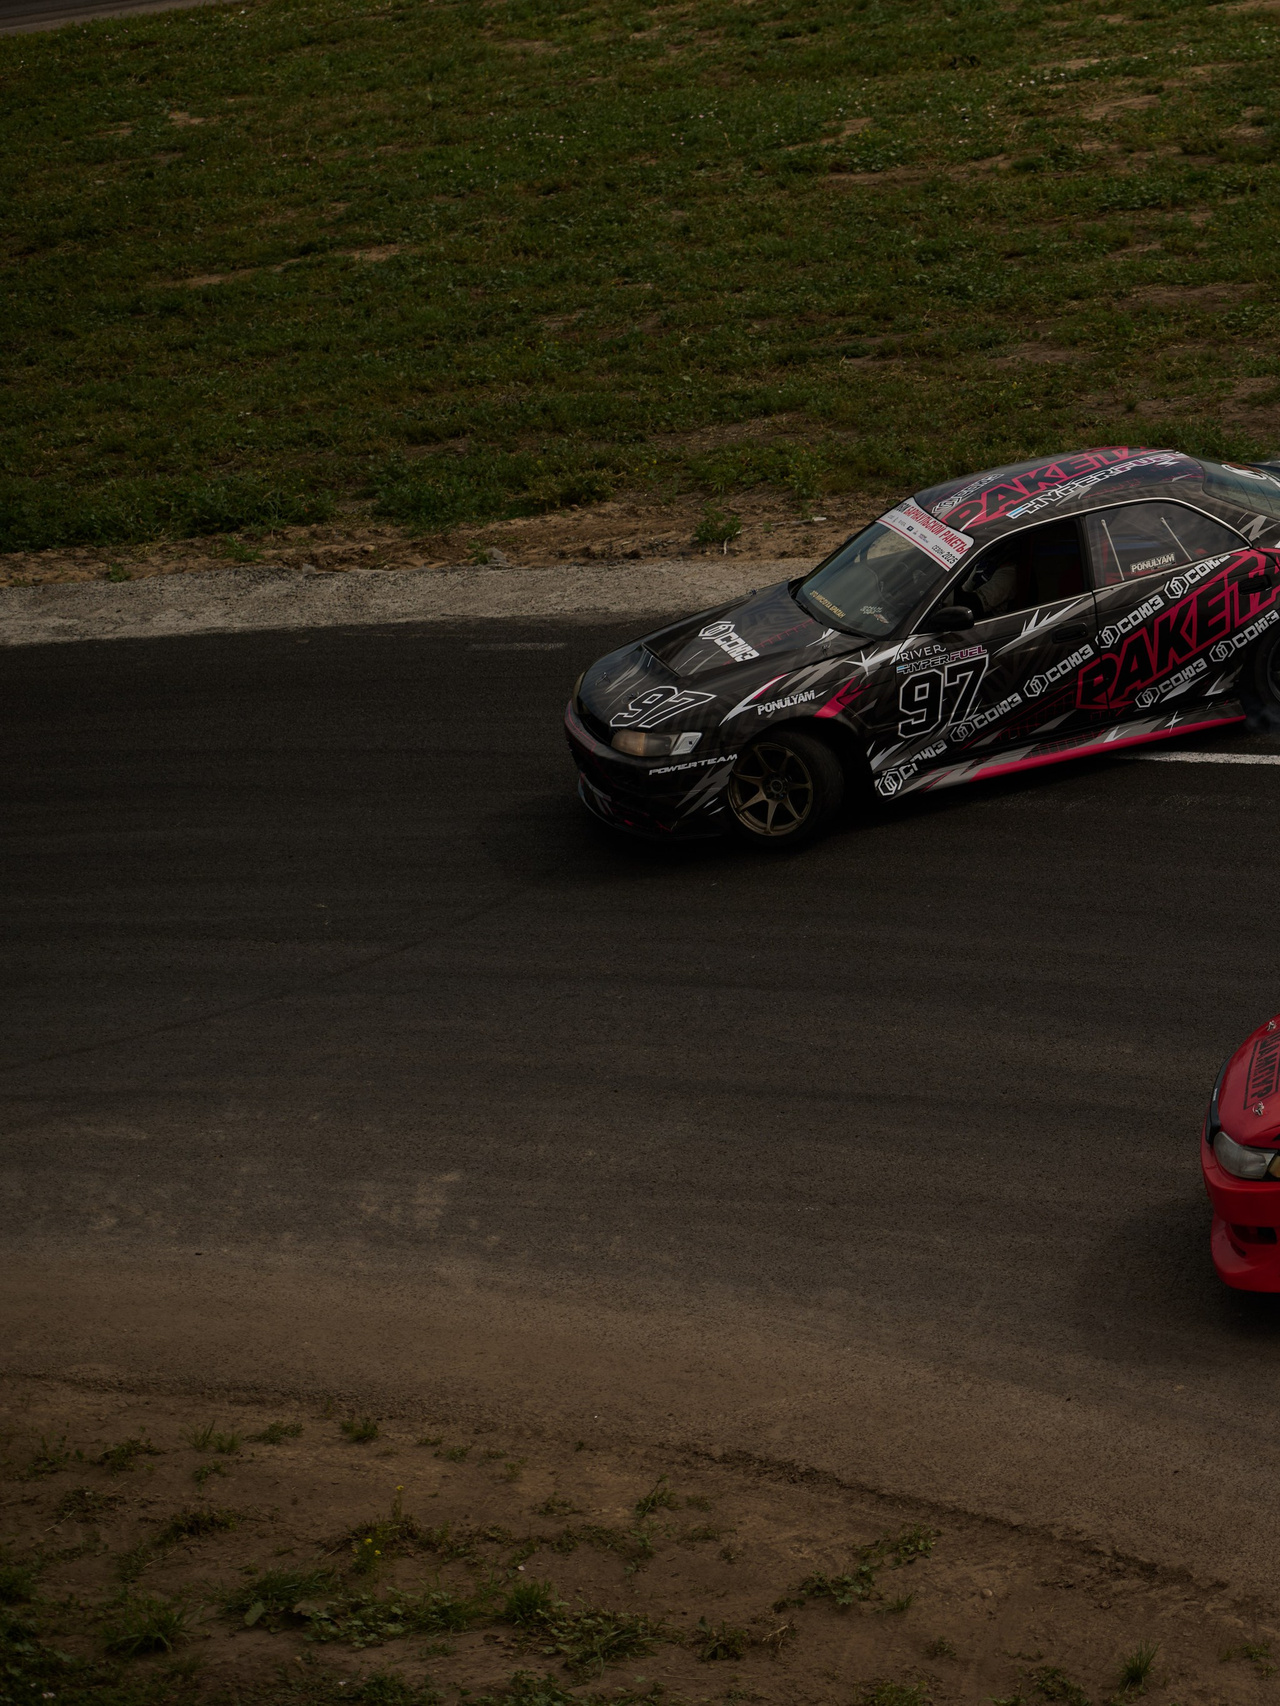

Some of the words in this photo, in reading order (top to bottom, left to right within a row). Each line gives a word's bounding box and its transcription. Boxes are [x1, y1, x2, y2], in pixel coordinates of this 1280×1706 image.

[1130, 553, 1176, 574] PONULYAM
[900, 645, 947, 662] RIVER
[610, 685, 717, 729] 97
[757, 690, 816, 716] PONULYAM
[897, 652, 990, 738] 97
